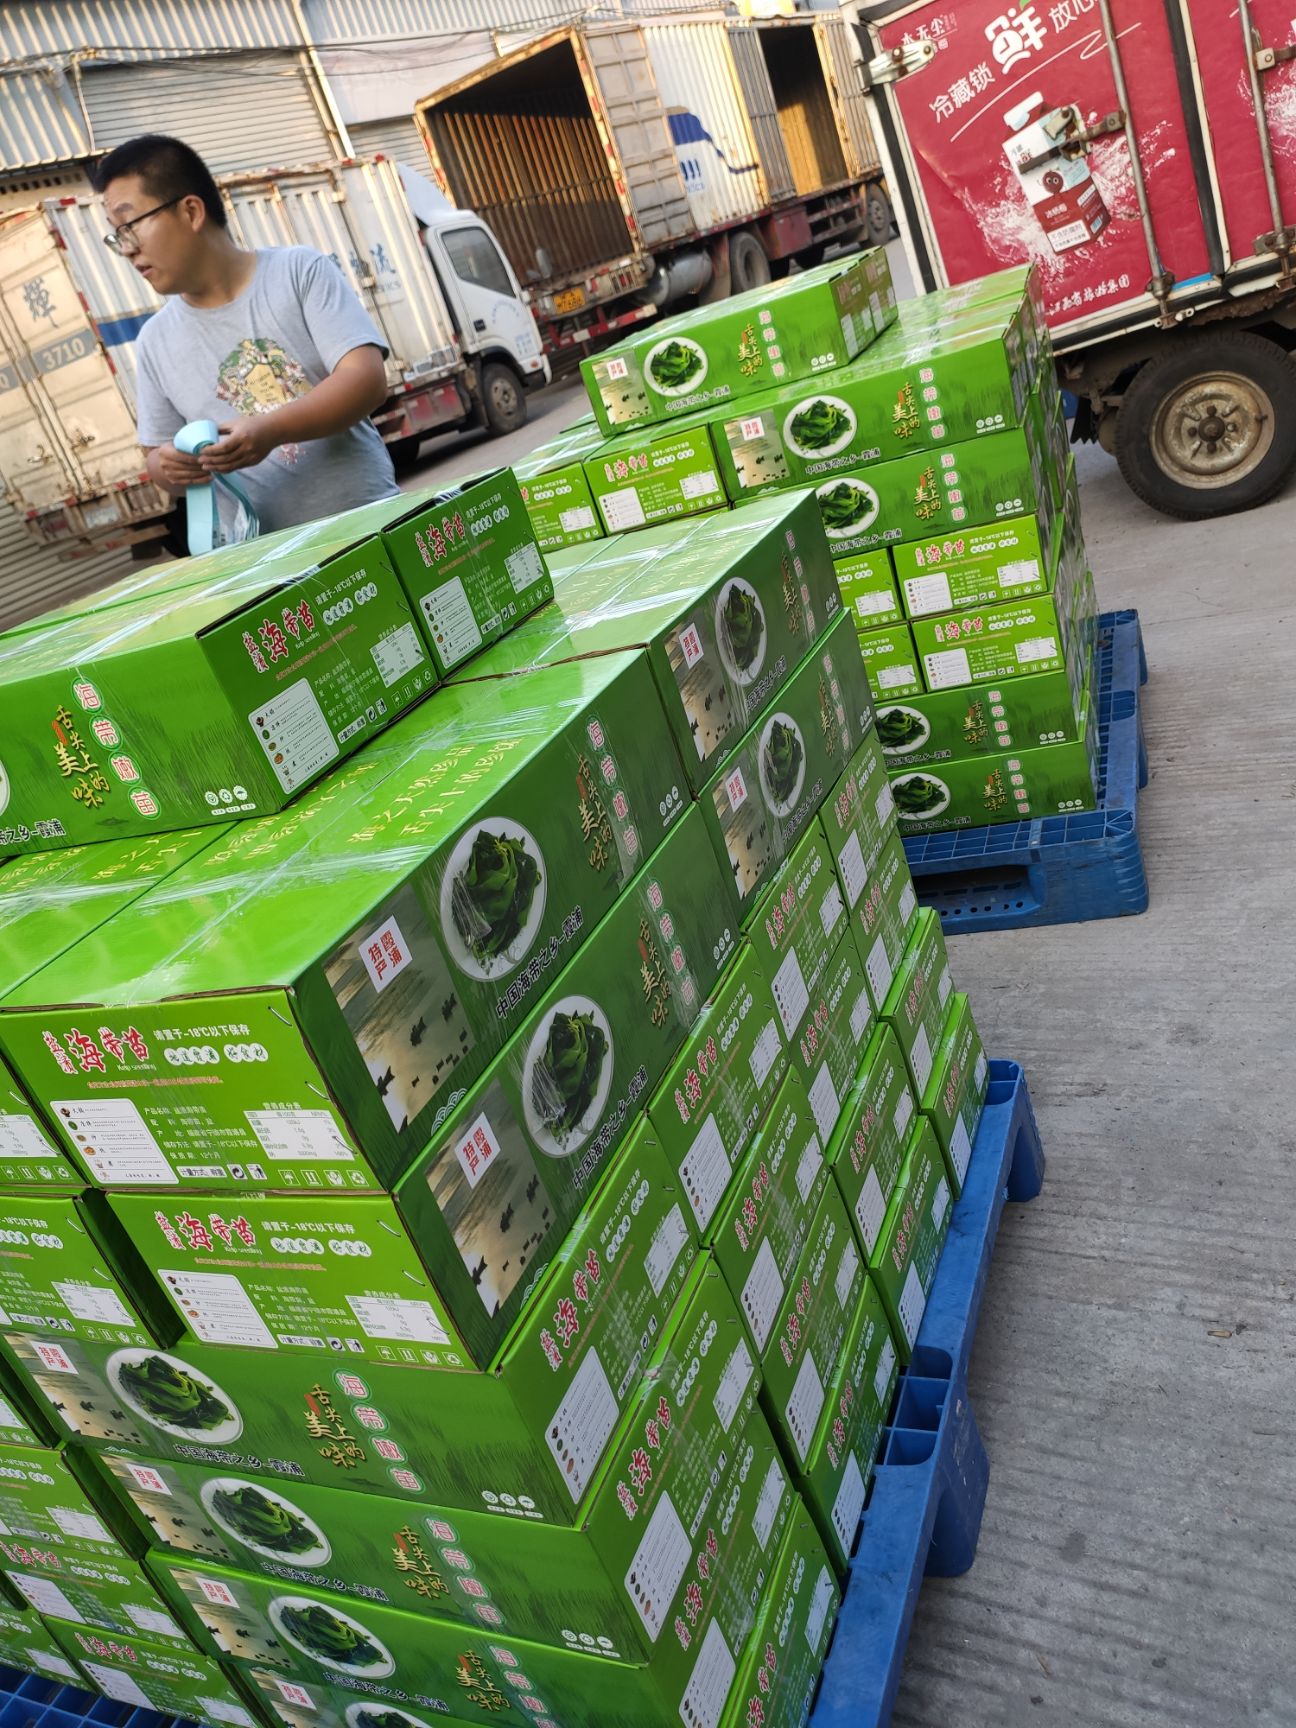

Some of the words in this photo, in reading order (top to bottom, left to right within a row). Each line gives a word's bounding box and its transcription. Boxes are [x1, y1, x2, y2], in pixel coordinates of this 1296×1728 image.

[43, 337, 86, 370] 3710
[258, 599, 315, 663] 海带苗
[53, 742, 104, 808] 美味
[56, 704, 110, 792] 舌尖上的
[63, 1025, 149, 1073] 海带苗
[175, 1211, 256, 1252] 海带苗
[553, 1248, 600, 1348] 海带苗
[628, 1396, 671, 1496] 海带苗
